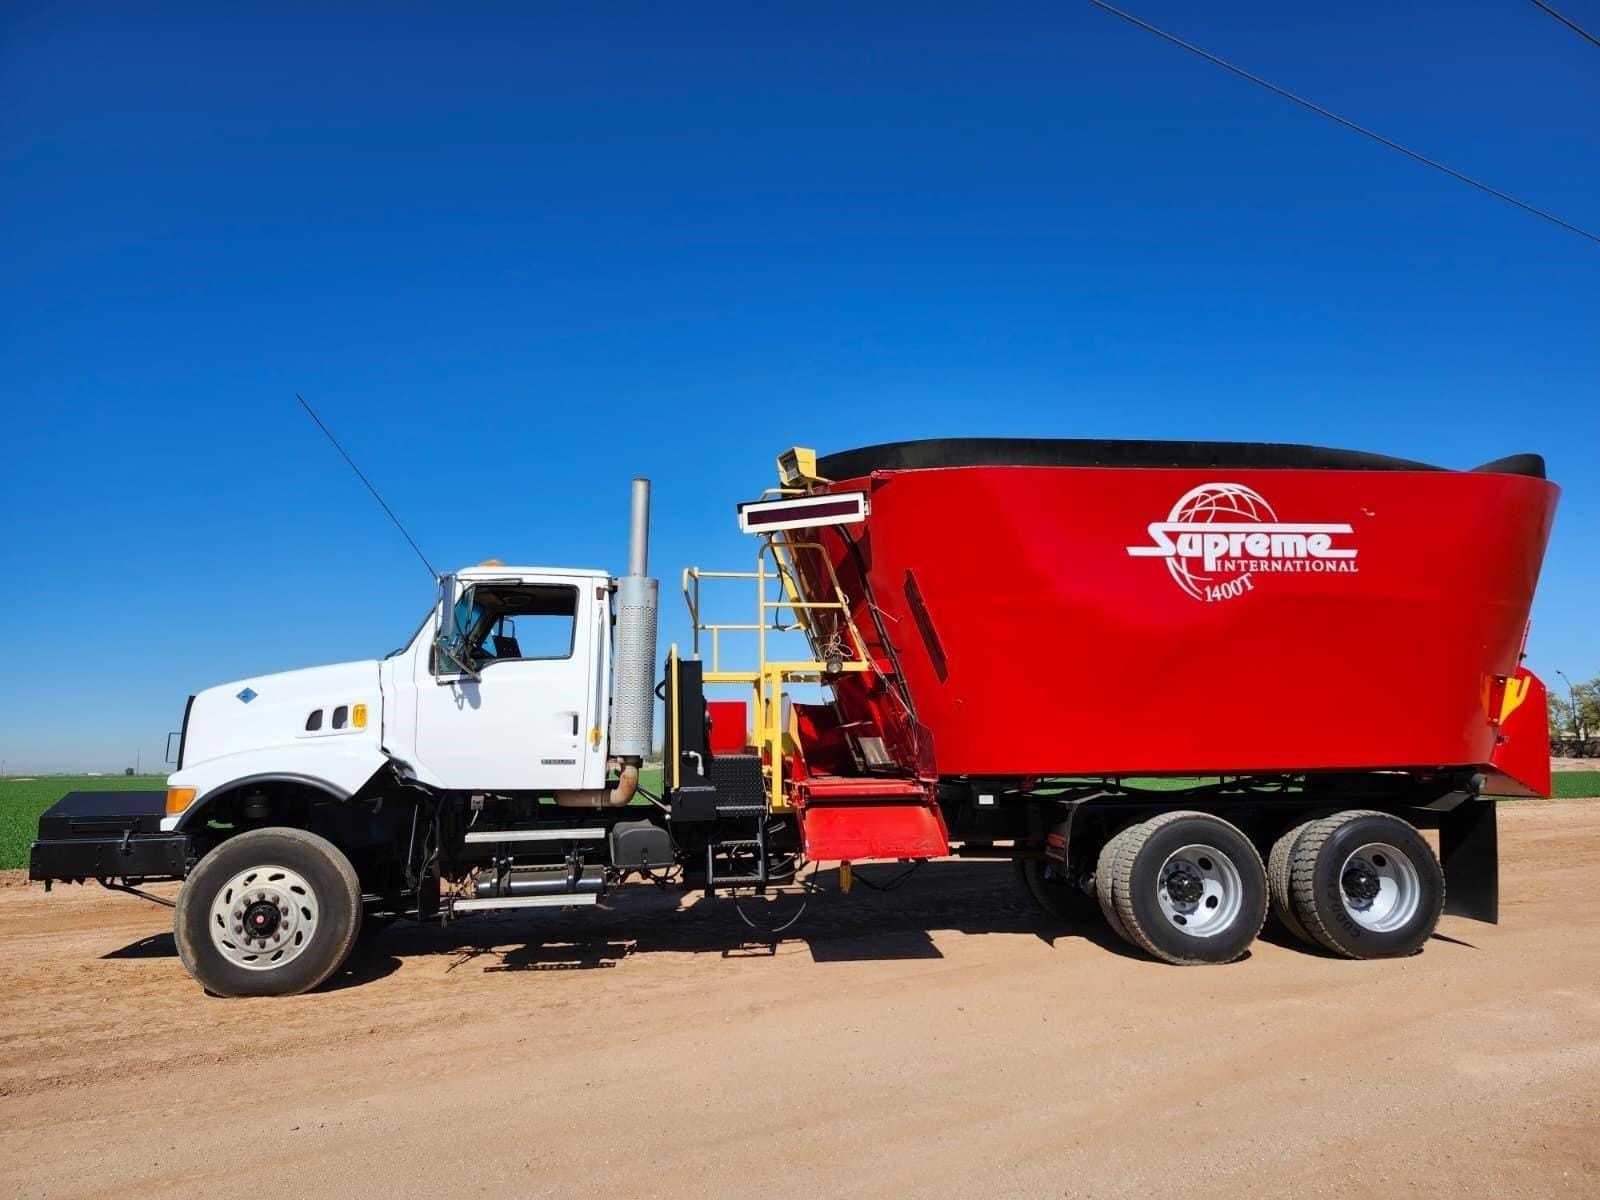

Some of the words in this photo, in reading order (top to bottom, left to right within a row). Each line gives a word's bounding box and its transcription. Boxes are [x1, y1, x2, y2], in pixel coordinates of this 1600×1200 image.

[1127, 522, 1358, 572] Supreme
[1215, 560, 1359, 572] INTERNATIONAL
[1204, 573, 1255, 602] 1400T
